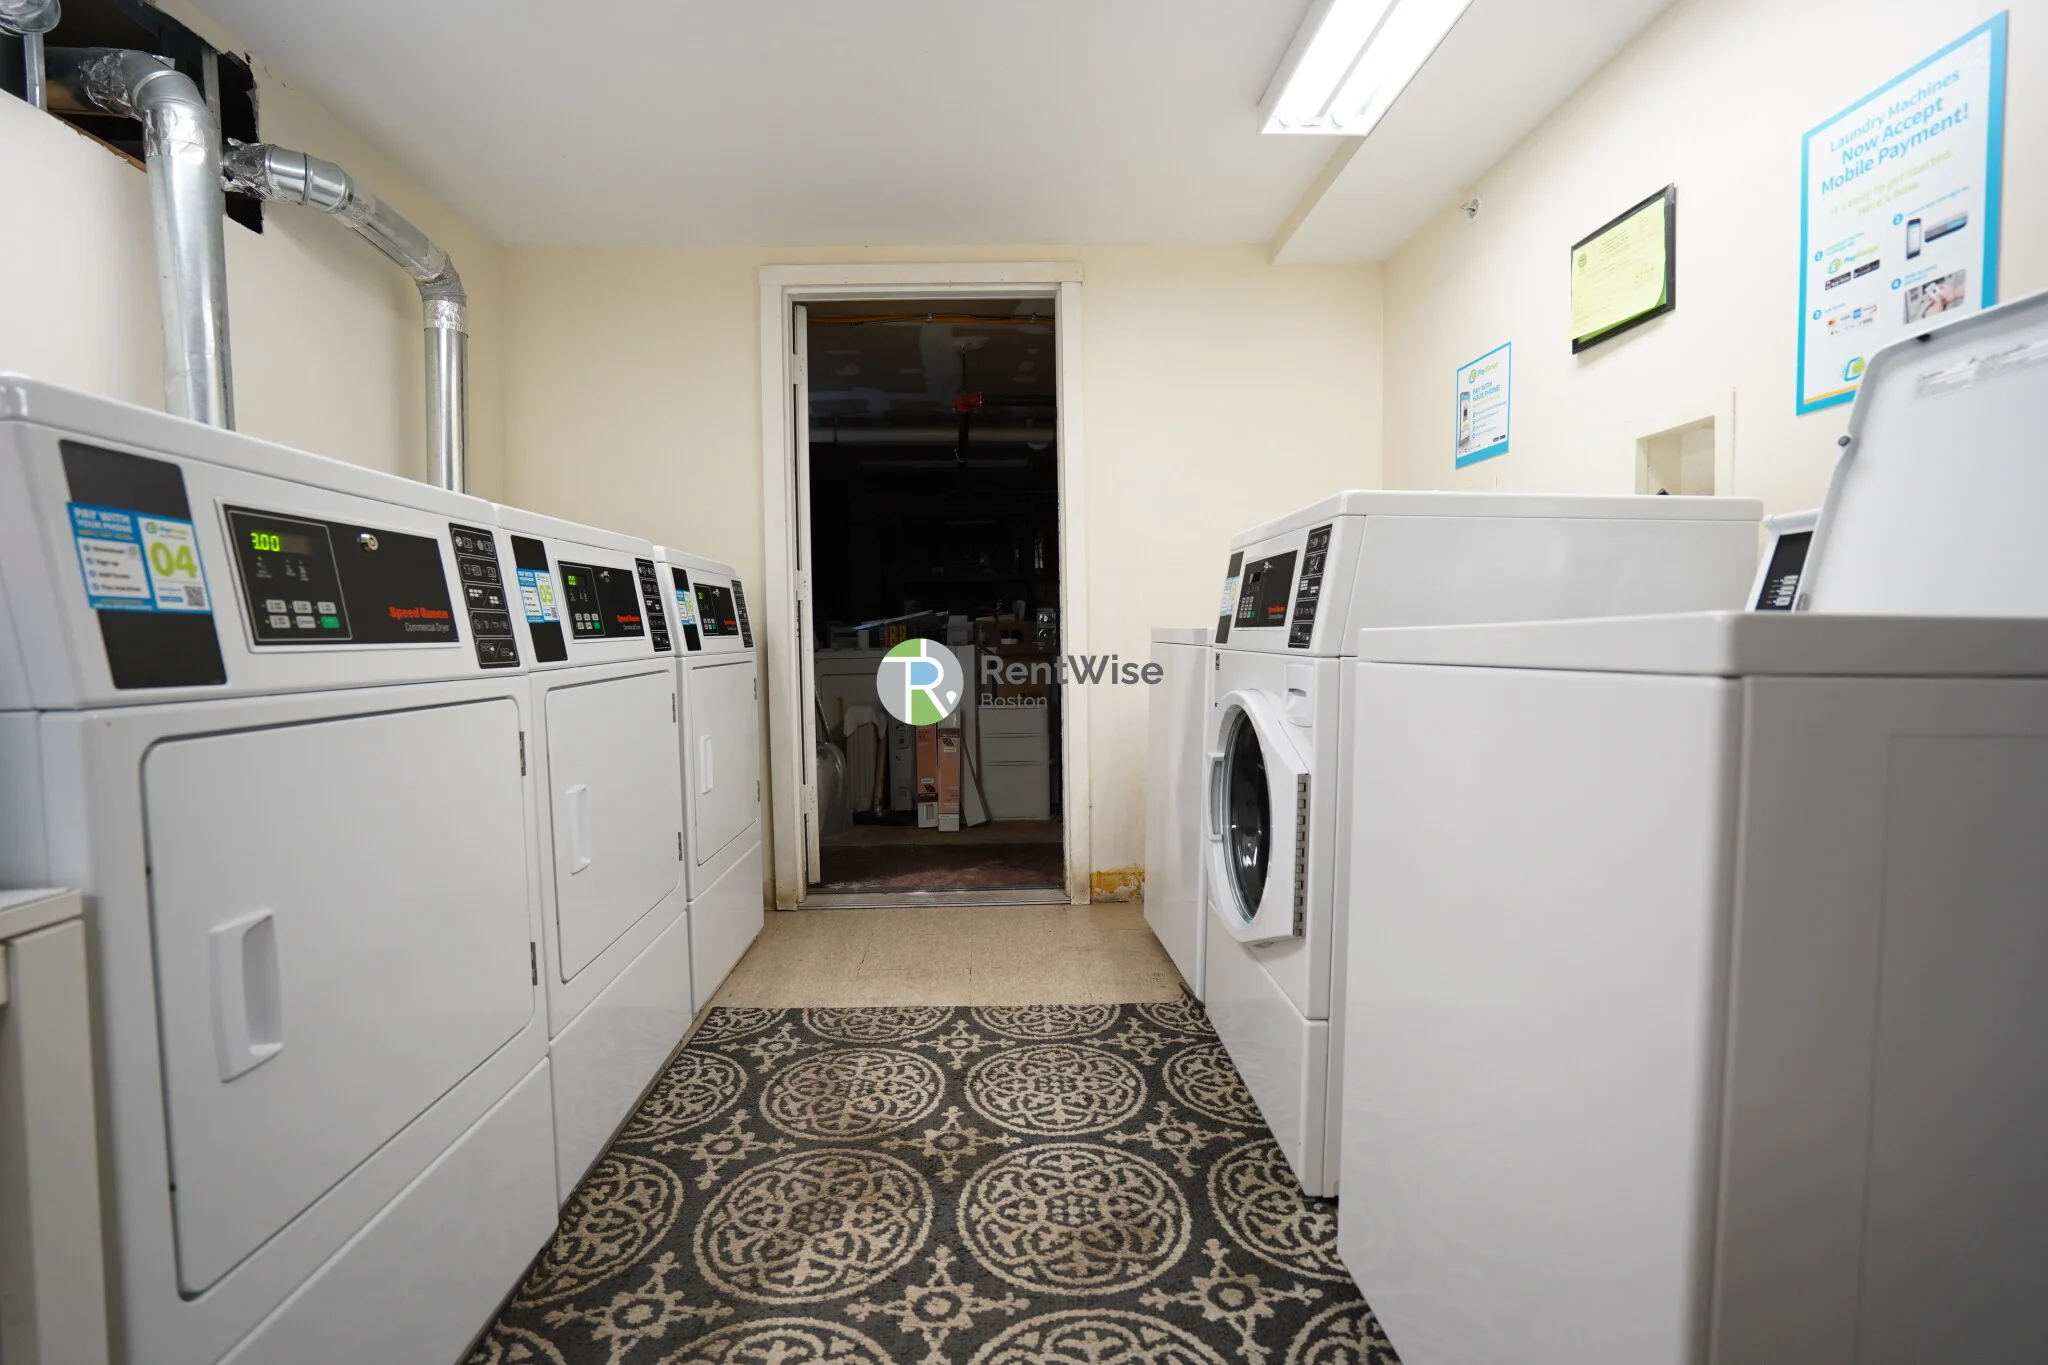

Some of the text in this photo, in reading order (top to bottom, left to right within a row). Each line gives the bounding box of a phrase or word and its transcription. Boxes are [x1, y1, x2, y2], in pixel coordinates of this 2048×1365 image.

[1829, 69, 1961, 152] Laundry Machines
[1842, 97, 1944, 165] Now Accept
[1821, 101, 1970, 195] Mobile Payment!
[150, 541, 198, 578] 04
[388, 606, 449, 621] Speed Queen
[540, 585, 553, 603] 05
